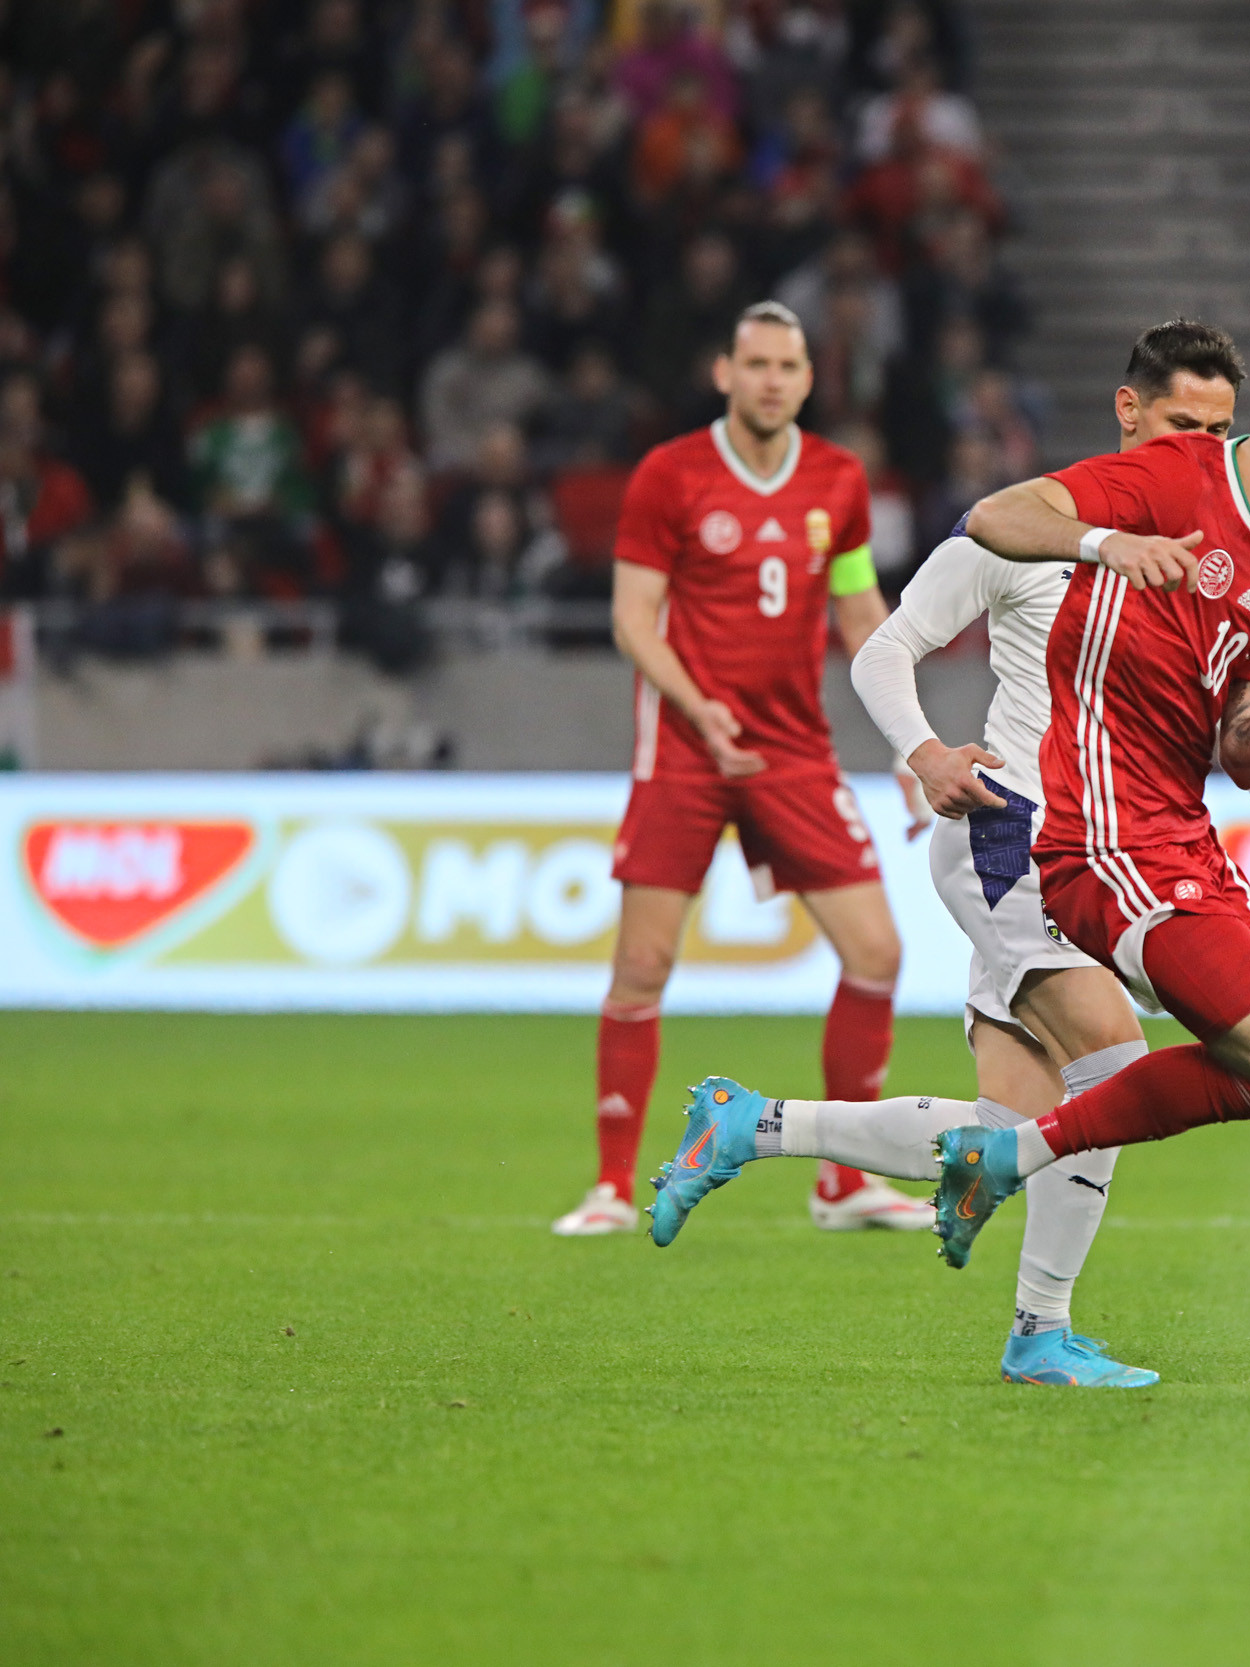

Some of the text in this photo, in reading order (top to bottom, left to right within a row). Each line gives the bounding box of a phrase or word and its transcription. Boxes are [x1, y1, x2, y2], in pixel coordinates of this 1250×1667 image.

[757, 556, 788, 618] 9
[1200, 620, 1249, 697] 10
[414, 837, 796, 946] MOE
